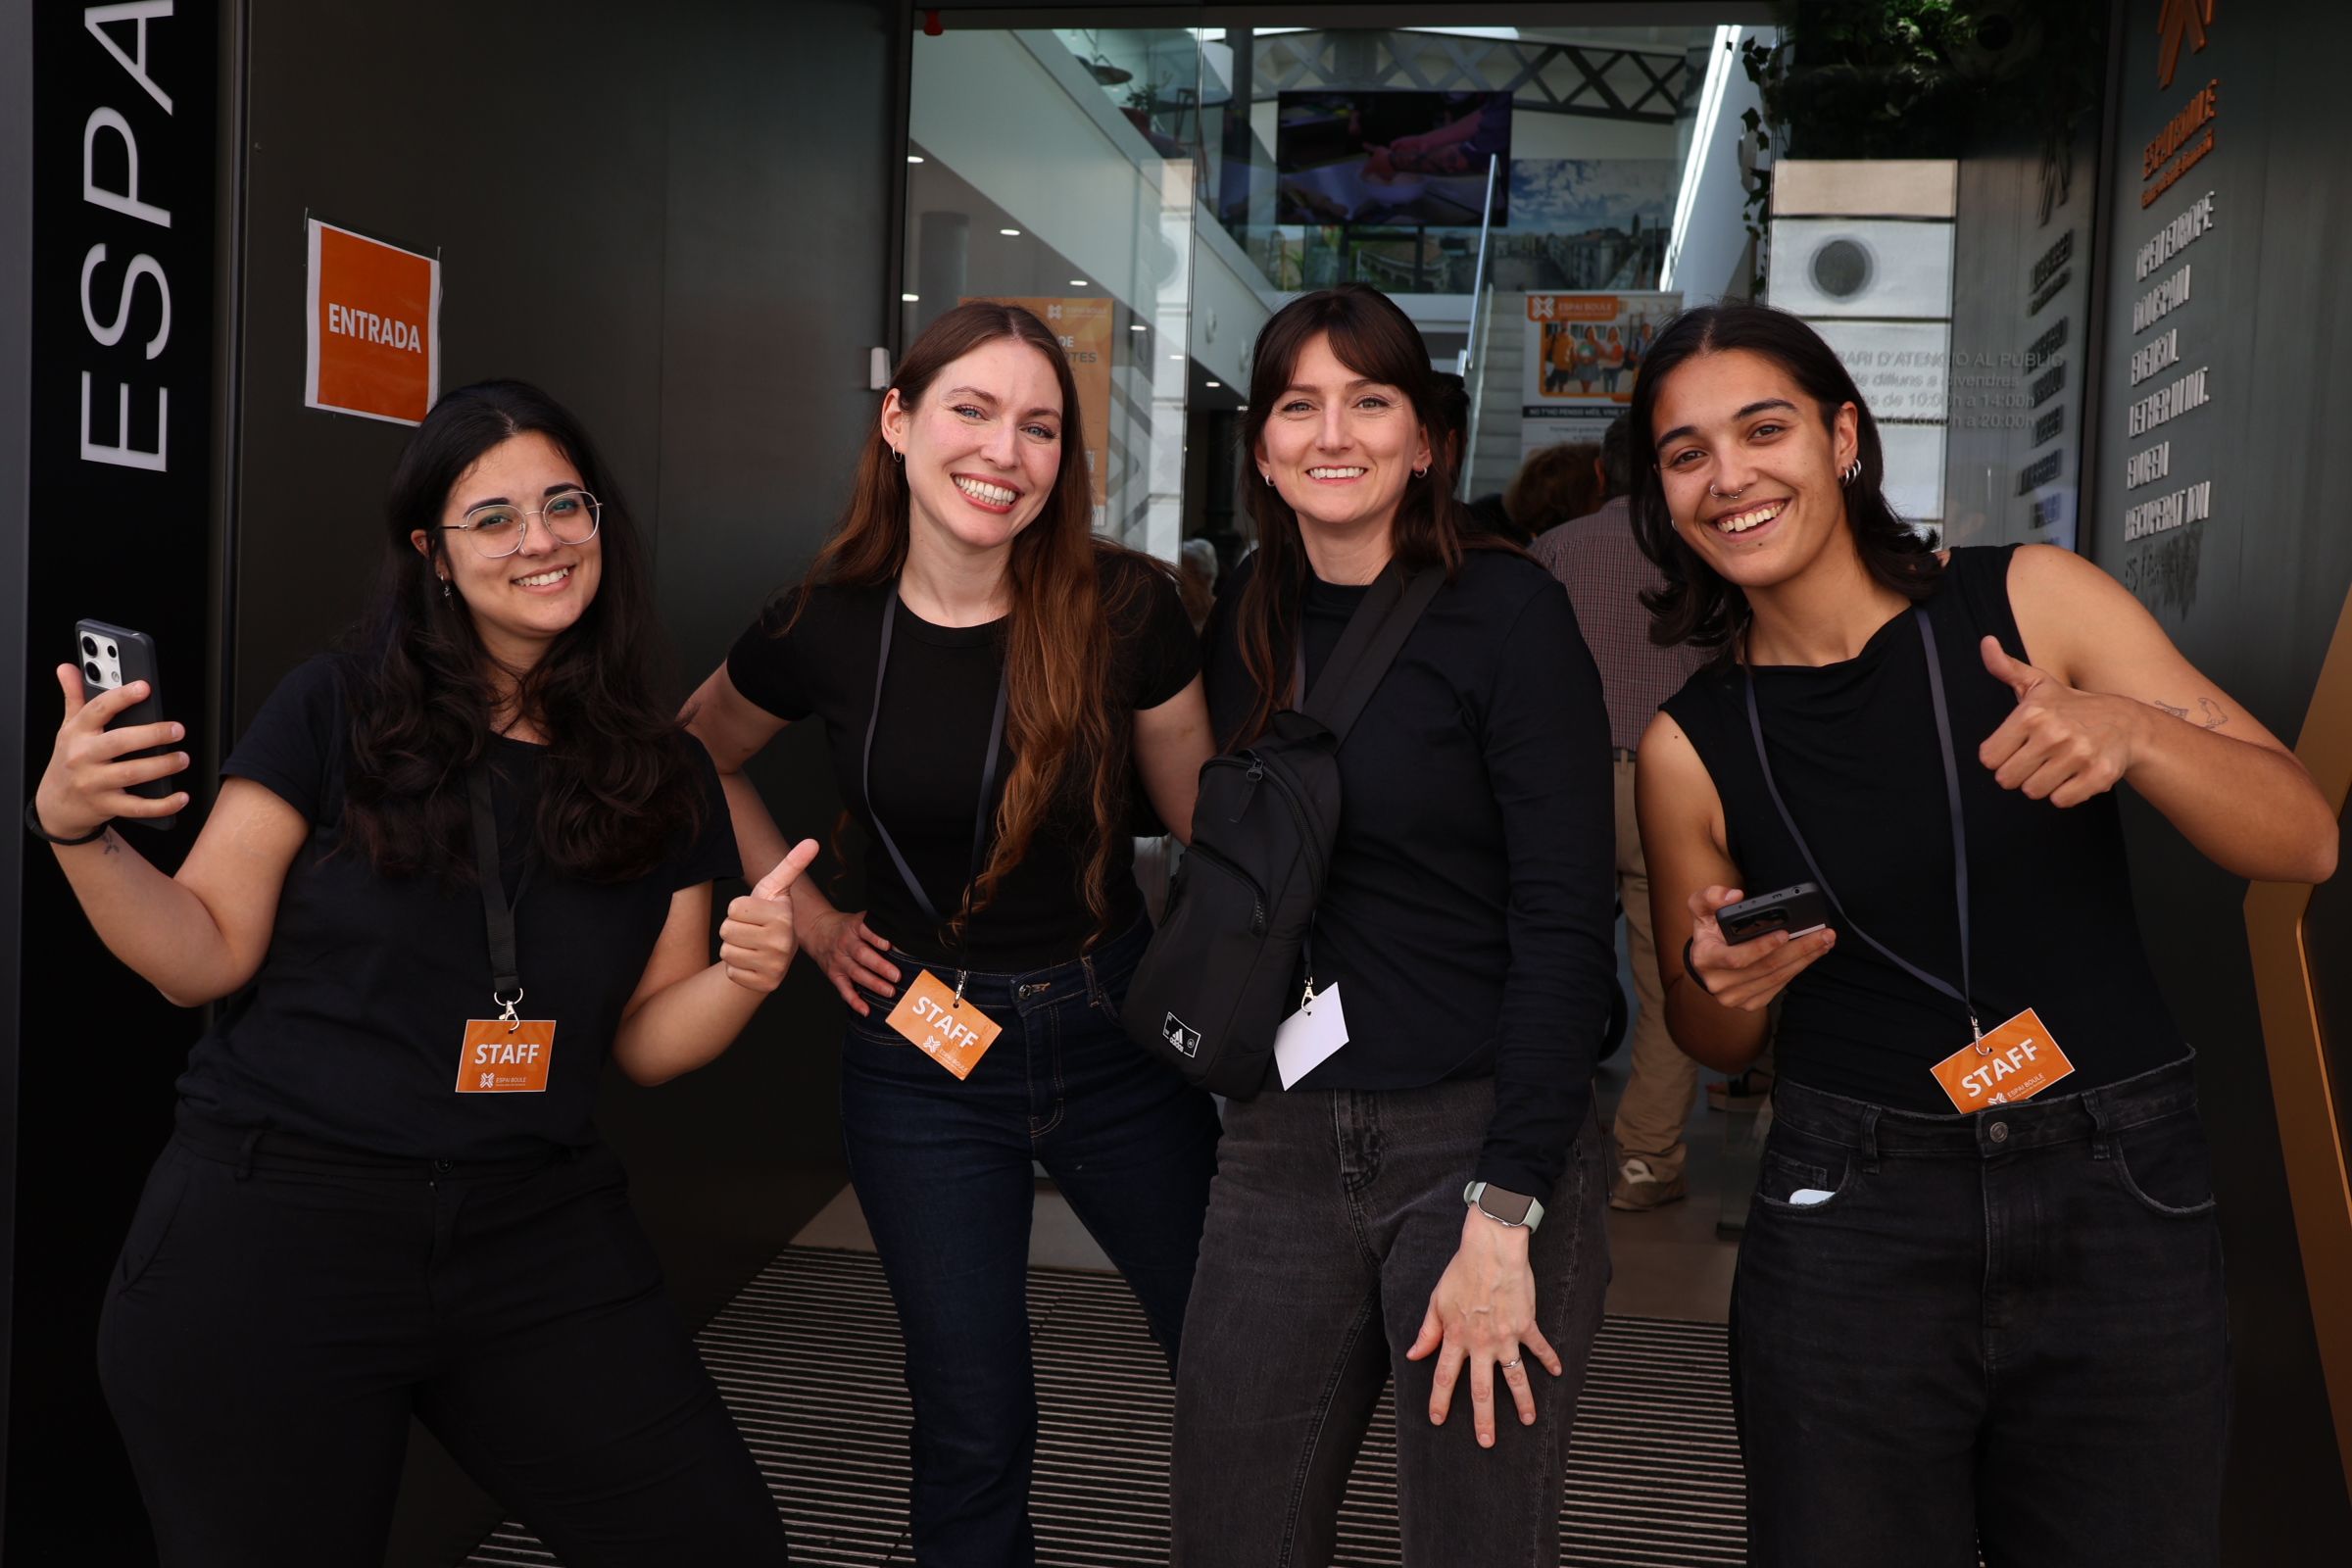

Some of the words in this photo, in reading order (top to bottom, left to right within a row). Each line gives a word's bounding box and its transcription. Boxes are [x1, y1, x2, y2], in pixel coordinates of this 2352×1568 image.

[2136, 230, 2167, 281] OPEN
[2165, 191, 2215, 261] EUROPE
[328, 302, 422, 355] ENTRADA
[1838, 351, 1873, 368] RARI
[1973, 352, 1994, 367] AL
[2000, 350, 2064, 368] PÚBLIC
[1873, 371, 1923, 386] dilluns
[1927, 376, 1938, 386] a
[1883, 392, 1903, 408] de
[1966, 397, 1976, 408] a
[1982, 393, 2035, 408] 14:00h
[1981, 413, 2035, 428] 20:00h
[911, 996, 979, 1049] STAFF
[474, 1043, 540, 1065] STAFF
[1961, 1038, 2037, 1098] STAFF
[2007, 1084, 2026, 1098] ESPAI
[2024, 1072, 2044, 1088] BOULE
